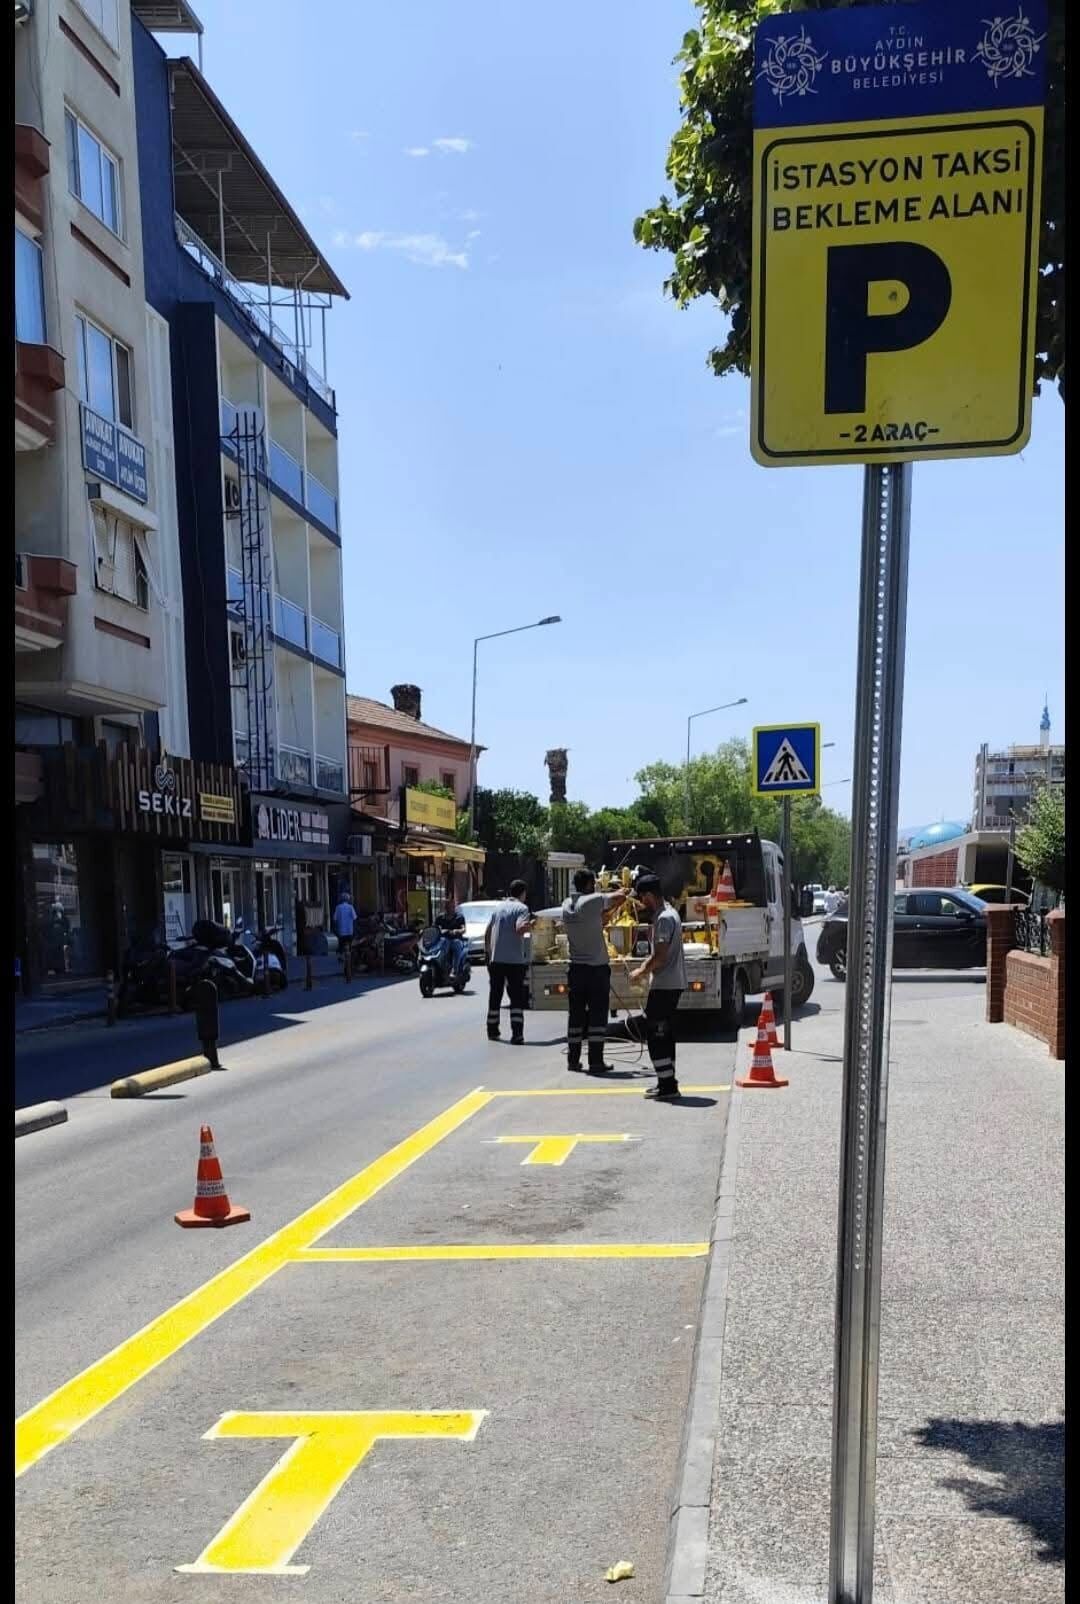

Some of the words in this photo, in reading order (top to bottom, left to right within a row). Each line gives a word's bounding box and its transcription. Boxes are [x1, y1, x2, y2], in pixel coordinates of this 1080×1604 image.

[831, 46, 966, 74] BÜYÜKŞEHİR
[875, 37, 923, 51] AYDIN
[853, 70, 943, 89] BELEDİYESİ
[774, 155, 923, 191] İSTASYON
[932, 140, 1021, 178] TAKSİ
[774, 197, 921, 230] BEKLEME
[928, 188, 1022, 219] ALANI
[824, 241, 952, 414] P
